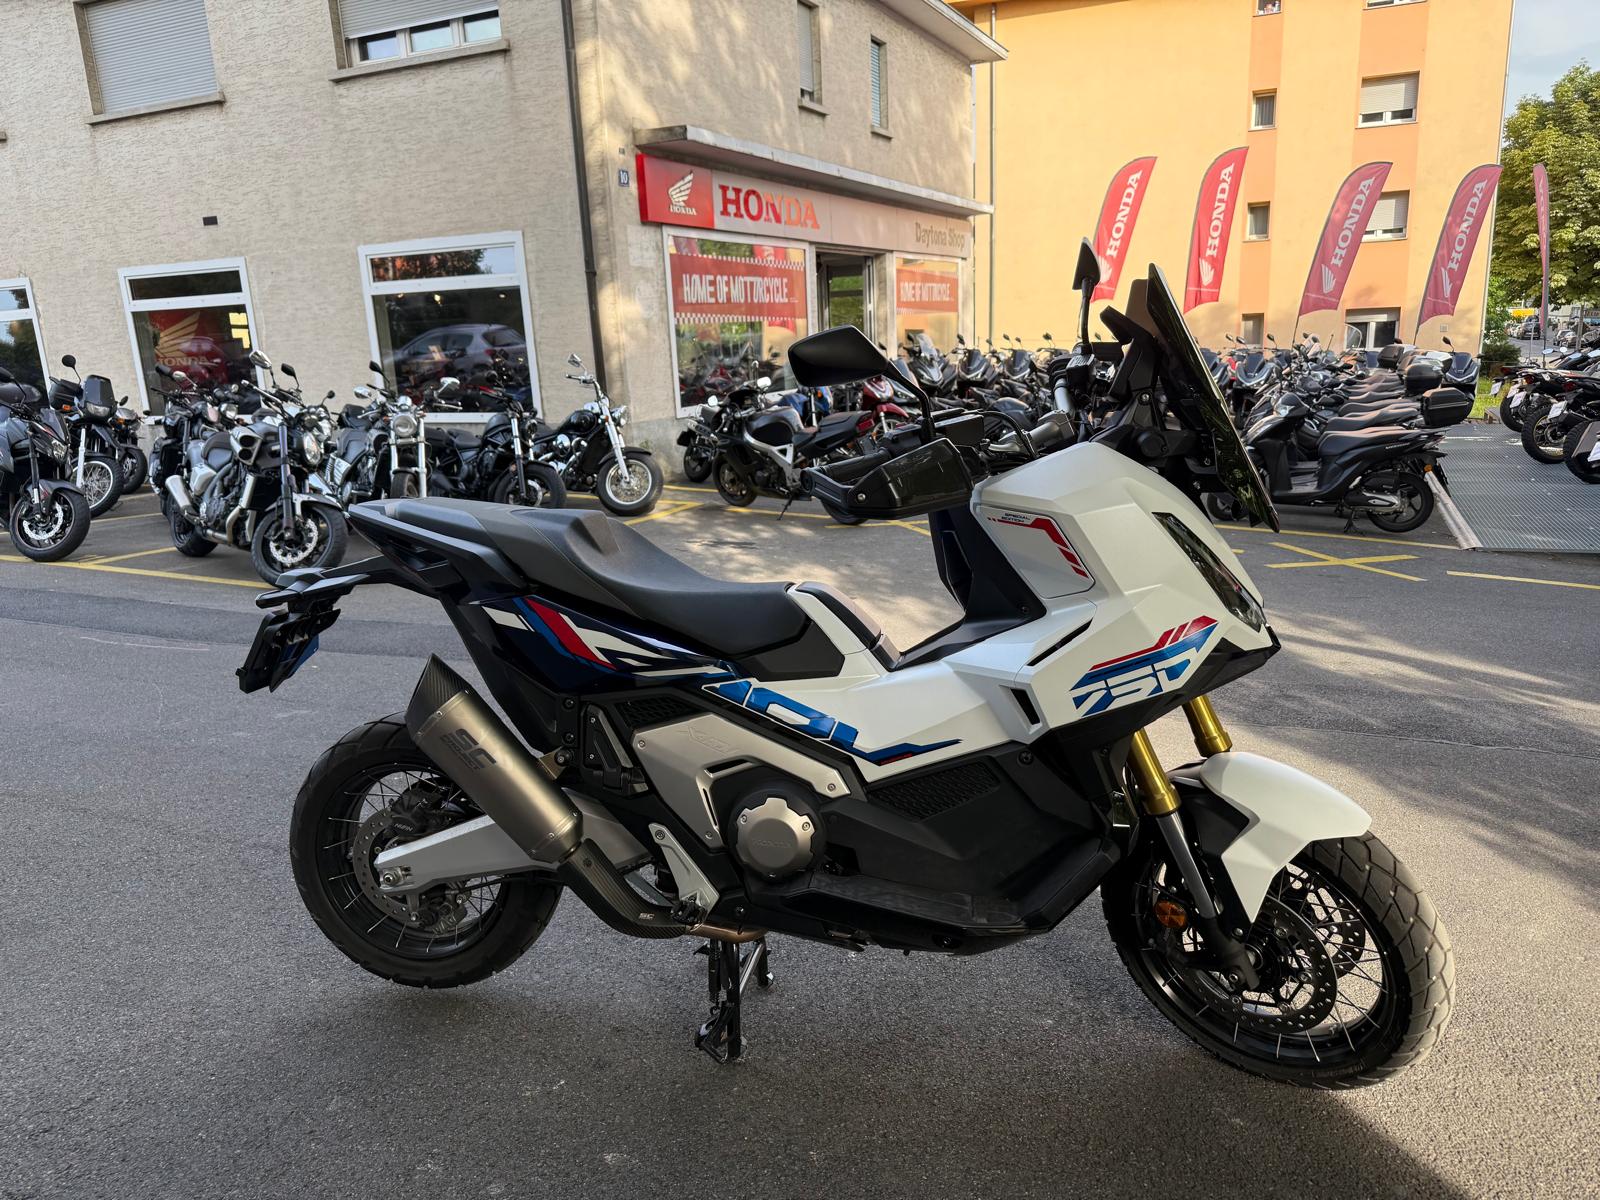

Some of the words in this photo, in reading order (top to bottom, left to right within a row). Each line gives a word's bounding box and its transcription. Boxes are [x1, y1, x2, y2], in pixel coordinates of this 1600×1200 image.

[620, 170, 628, 184] 10
[669, 205, 697, 216] HONDA
[719, 184, 820, 229] HONDA
[1106, 170, 1143, 258] HONDA
[1203, 163, 1235, 258] HONDA
[1331, 177, 1376, 268] HONDA
[1447, 180, 1488, 272] HONDA
[915, 222, 947, 247] Daytona
[948, 228, 966, 252] Shop
[682, 273, 716, 303] HOME
[716, 274, 728, 304] OF
[448, 728, 497, 770] SC
